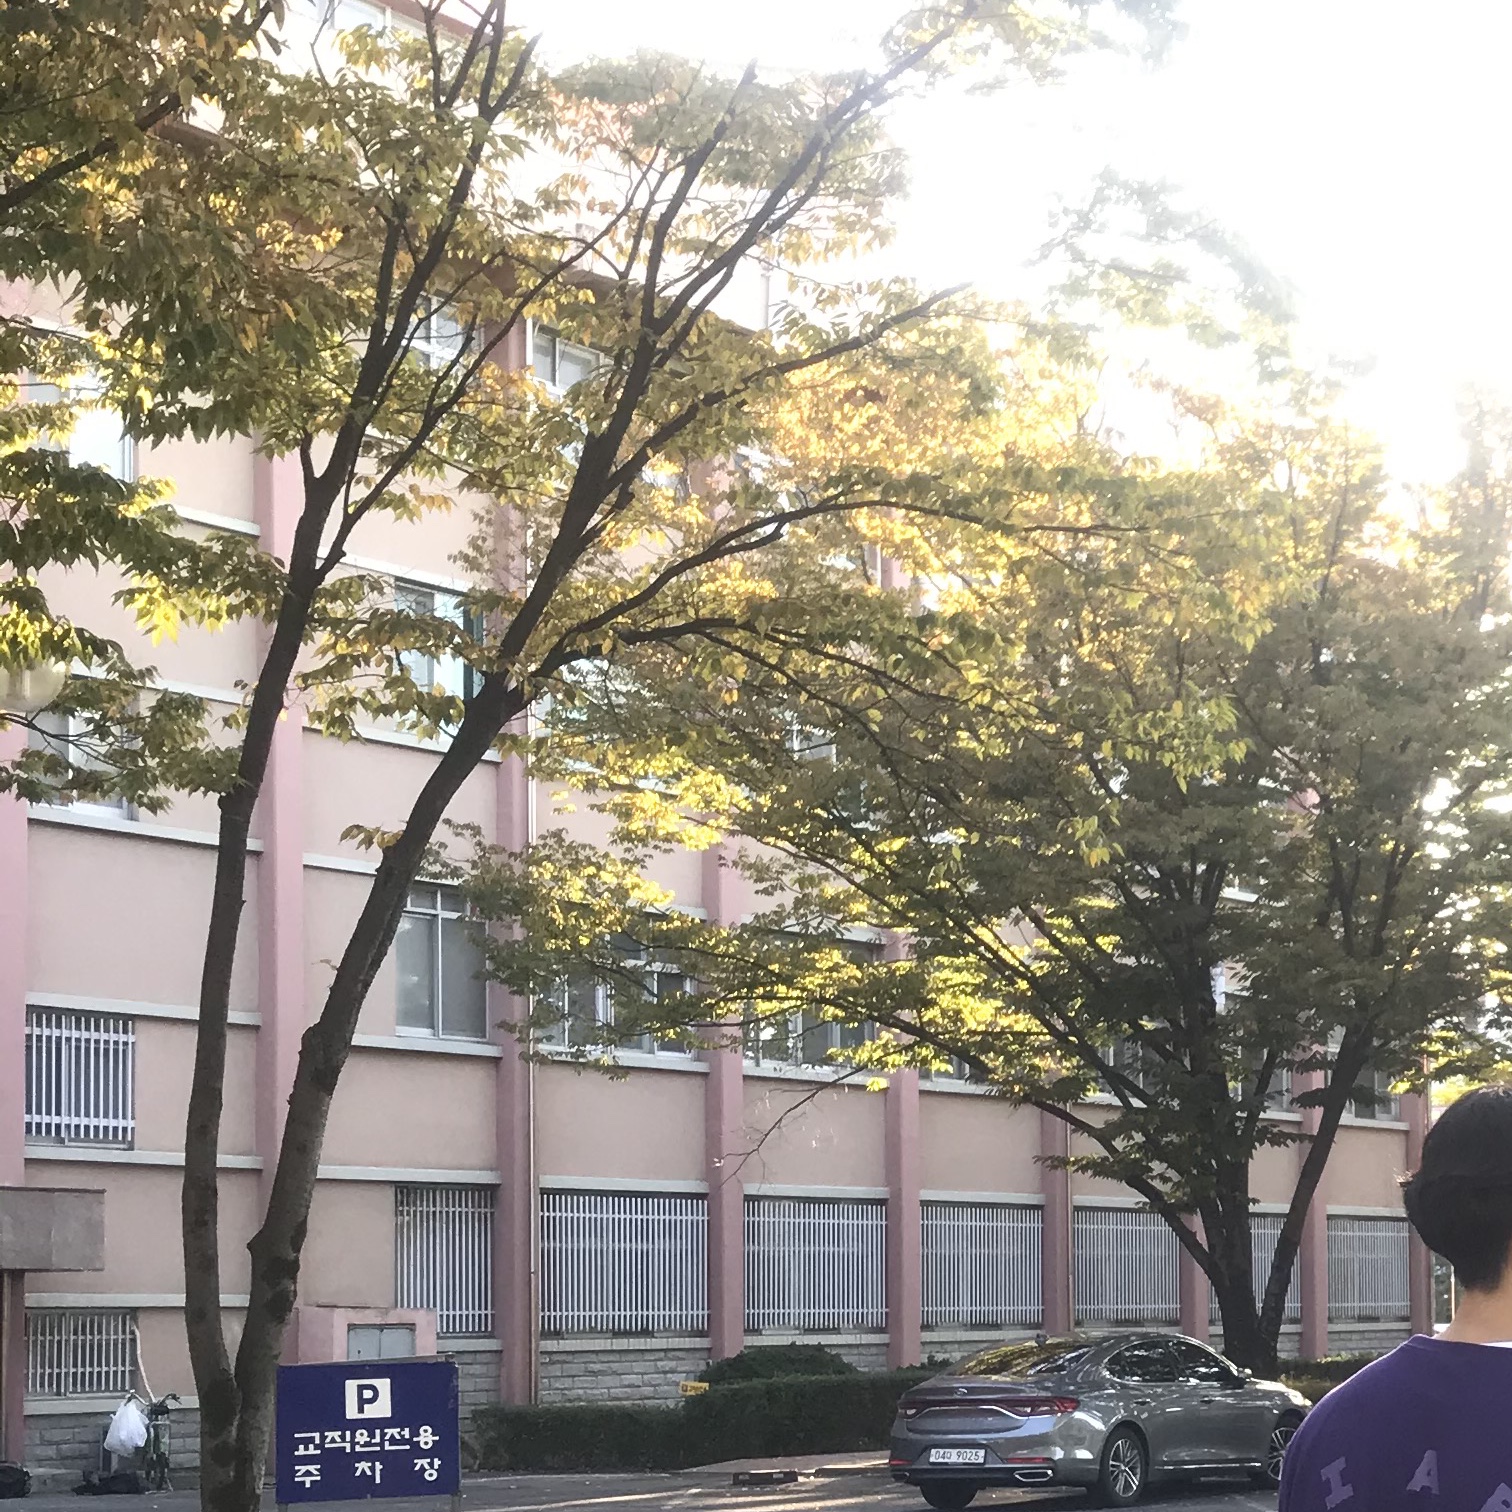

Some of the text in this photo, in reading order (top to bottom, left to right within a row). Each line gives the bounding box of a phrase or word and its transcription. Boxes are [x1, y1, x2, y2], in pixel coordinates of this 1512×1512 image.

[356, 1384, 380, 1414] P
[294, 1425, 440, 1456] 교직원전용
[956, 1450, 980, 1461] 9025
